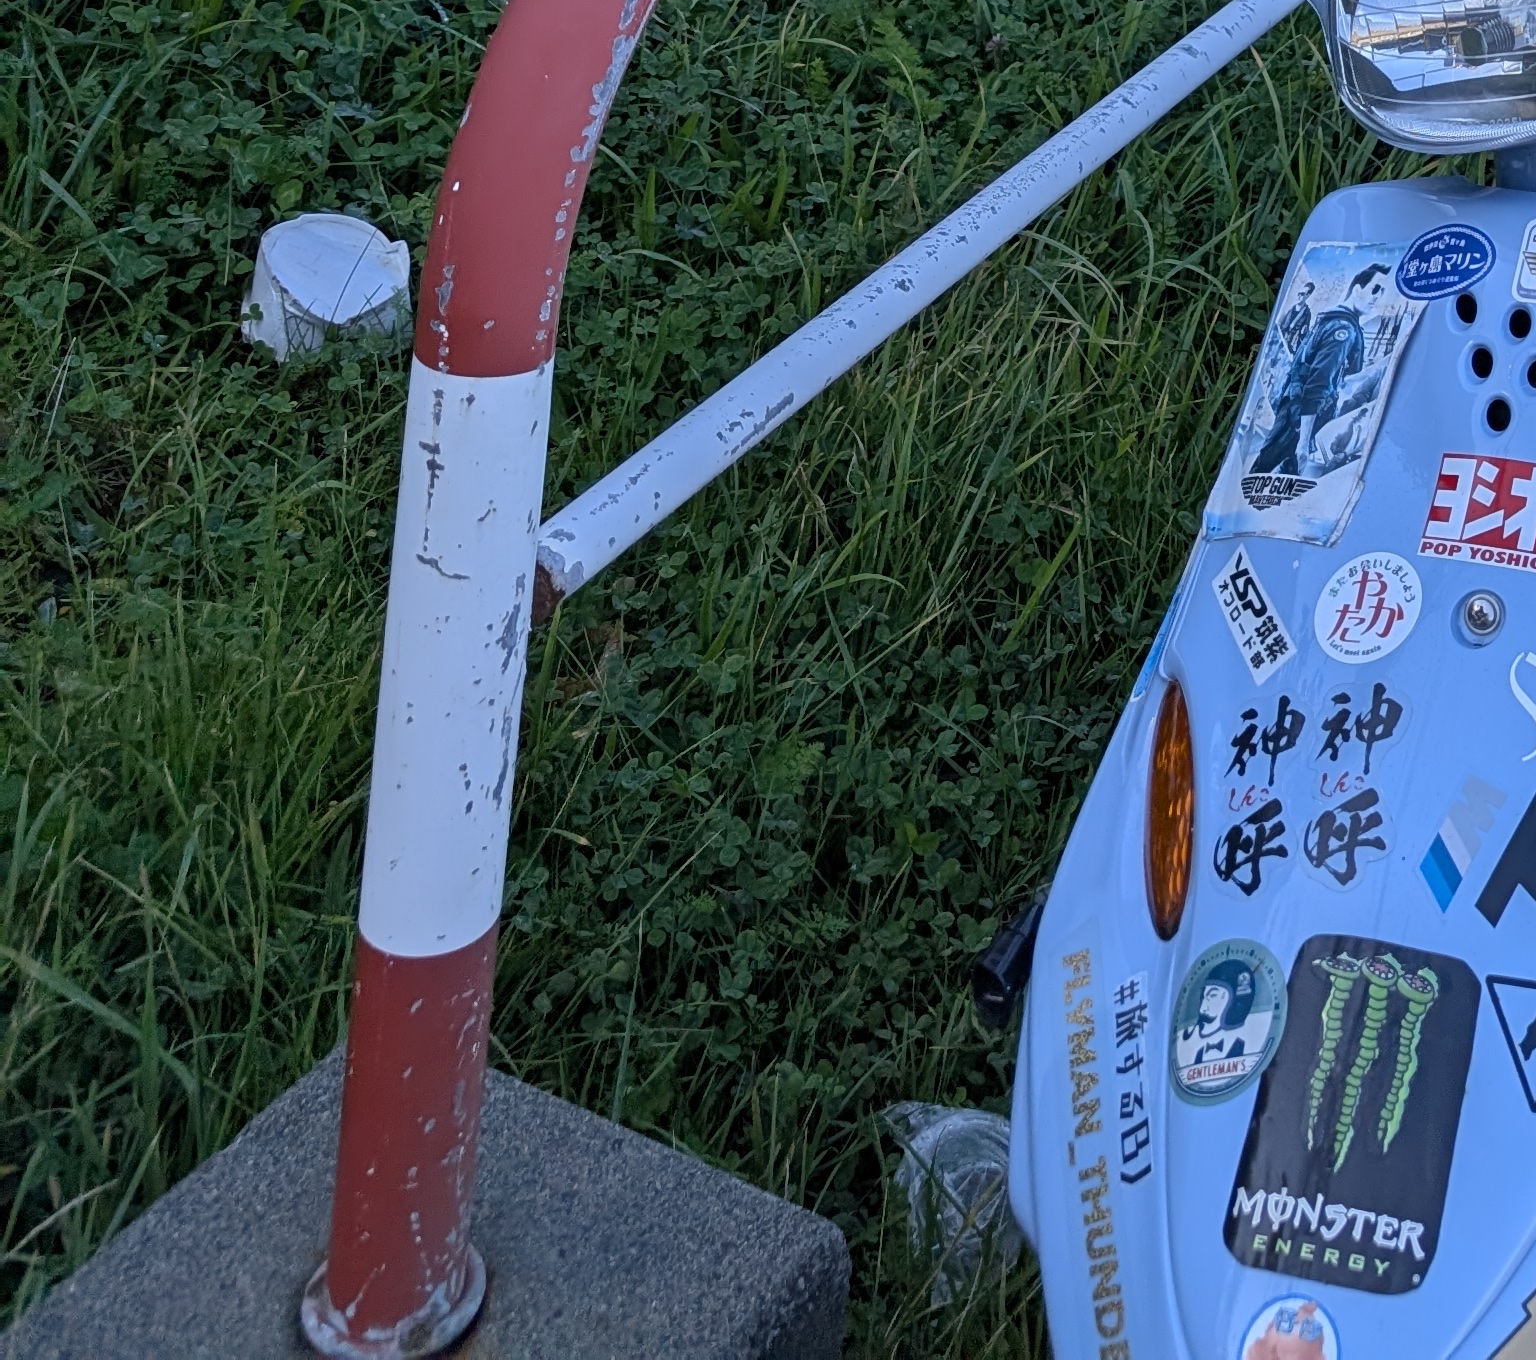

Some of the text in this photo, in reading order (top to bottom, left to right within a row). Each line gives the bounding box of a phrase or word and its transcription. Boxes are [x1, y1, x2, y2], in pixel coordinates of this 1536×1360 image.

[1251, 475, 1297, 496] TOP GUN
[1420, 540, 1463, 560] POP
[1186, 1058, 1247, 1082] GENTLEMAN'S
[1252, 1233, 1391, 1276] ENERGY
